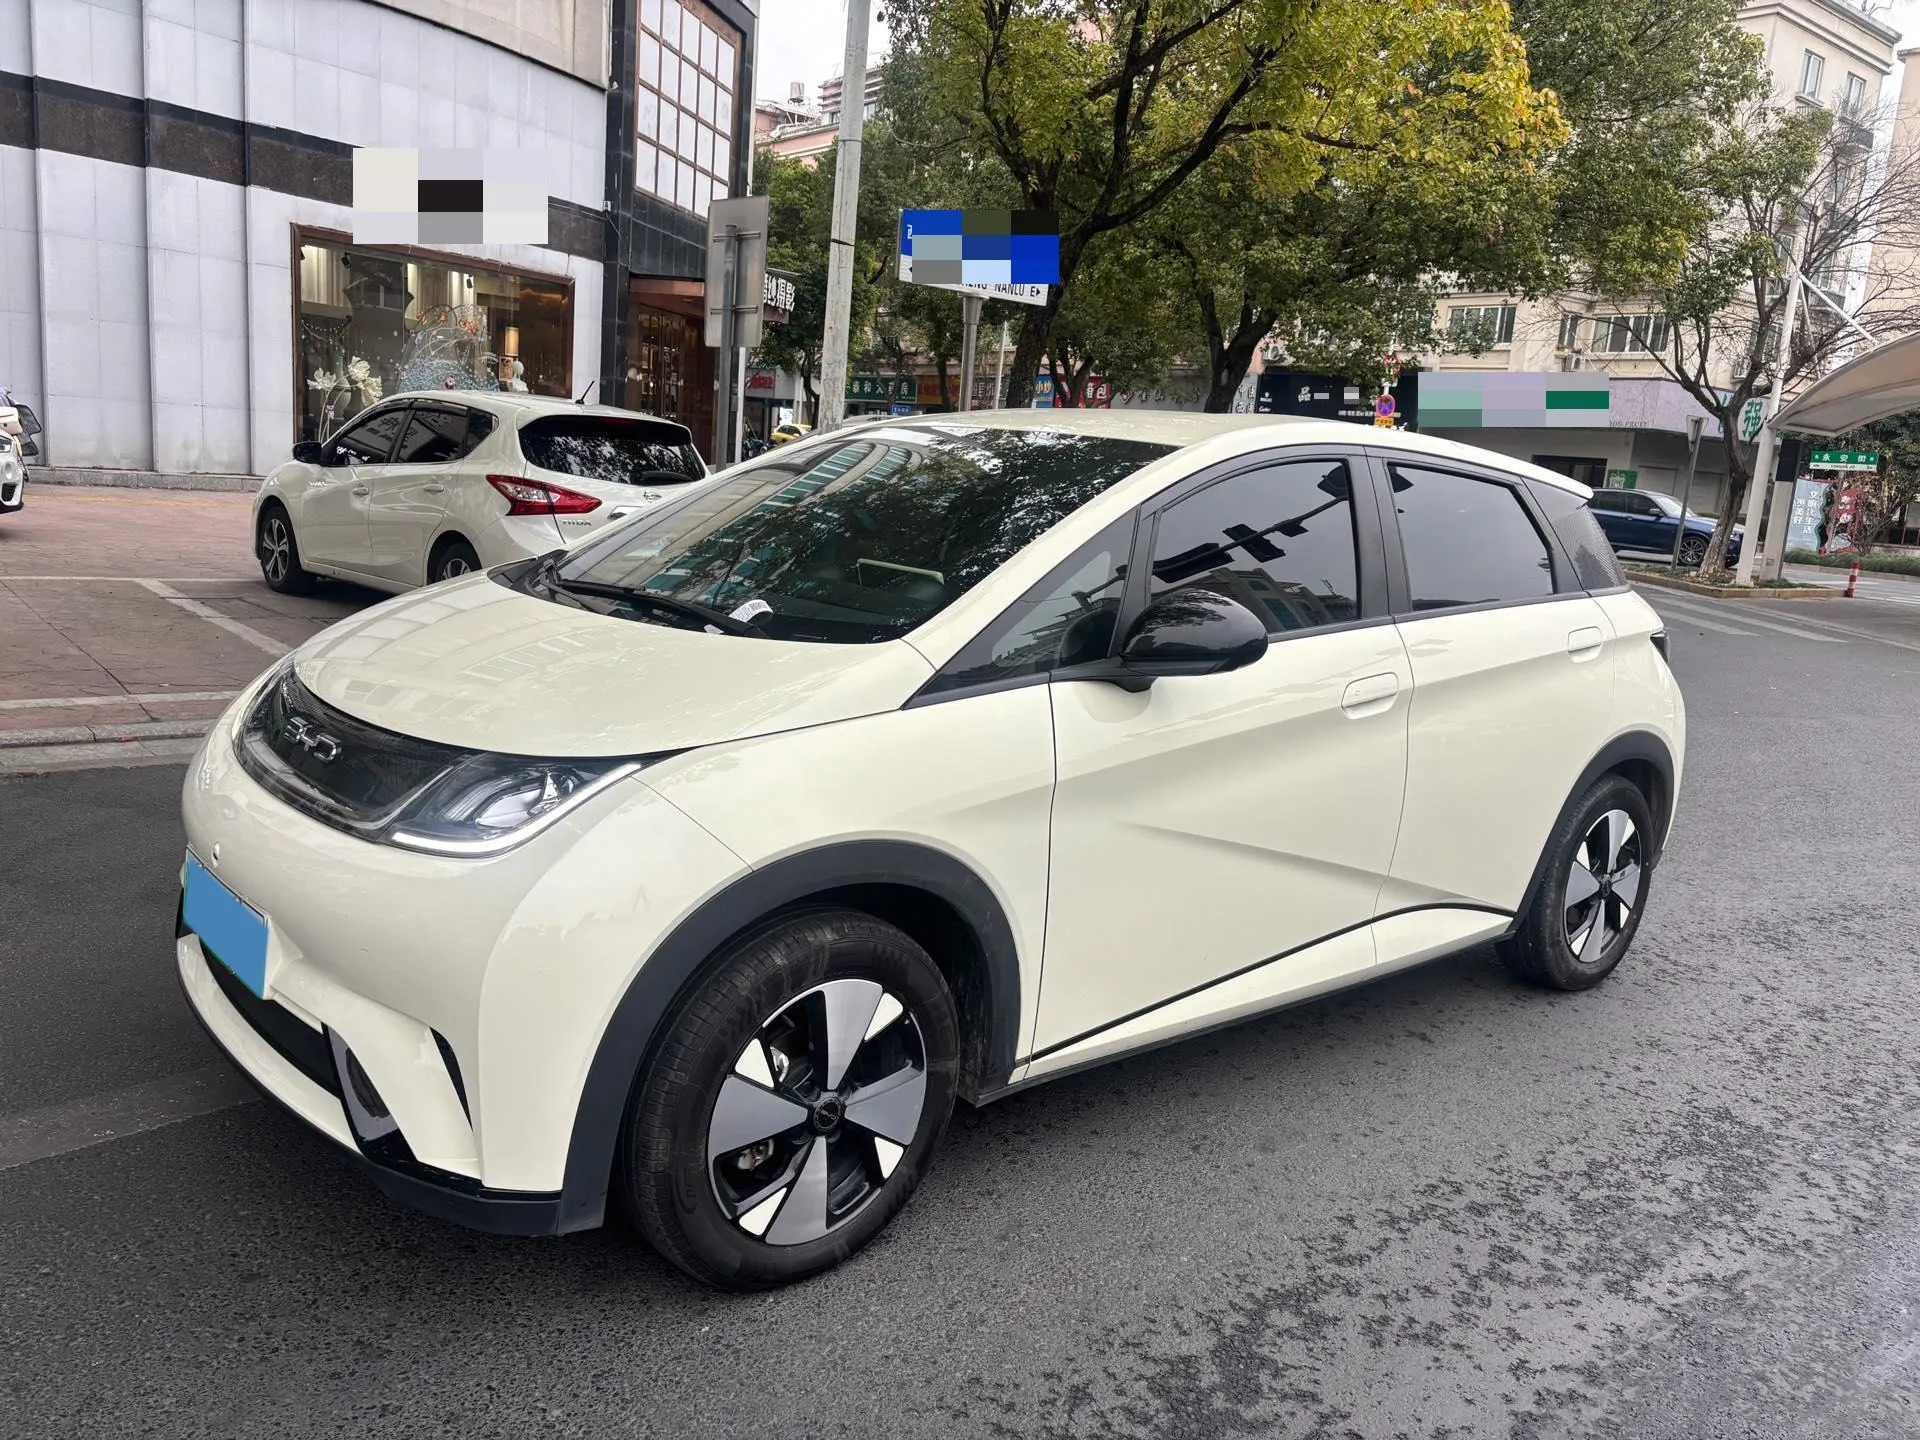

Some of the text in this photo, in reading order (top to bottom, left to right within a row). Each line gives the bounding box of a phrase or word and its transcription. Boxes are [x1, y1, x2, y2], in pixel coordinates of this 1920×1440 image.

[1030, 286, 1036, 297] E
[1822, 453, 1867, 463] 永安街
